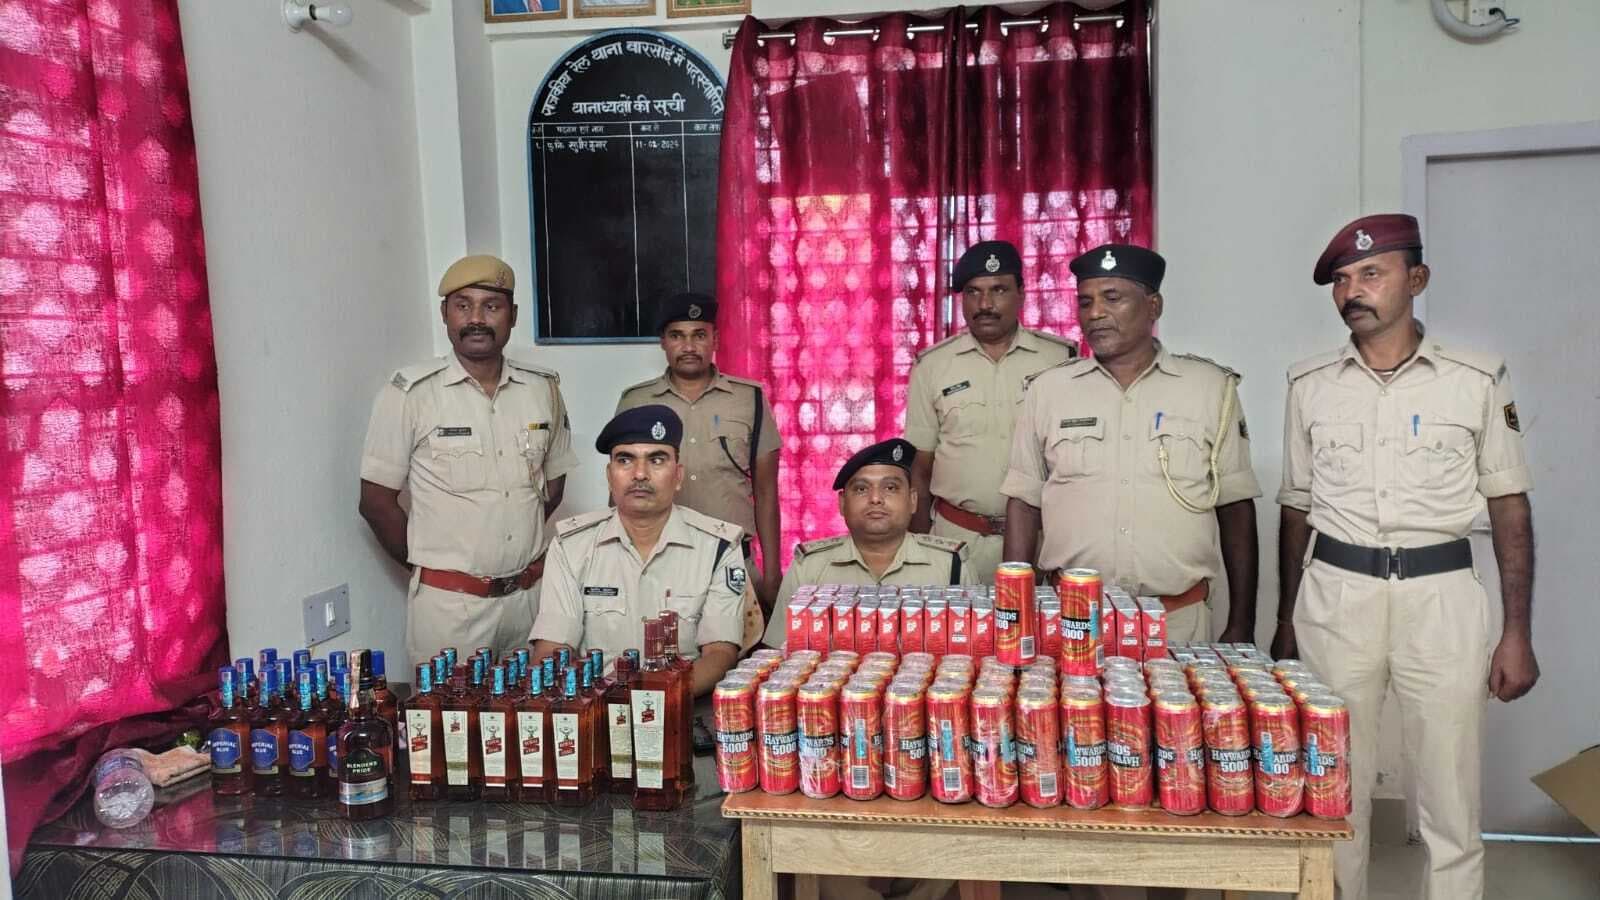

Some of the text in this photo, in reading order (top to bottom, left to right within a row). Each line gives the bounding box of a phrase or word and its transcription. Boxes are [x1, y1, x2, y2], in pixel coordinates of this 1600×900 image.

[565, 55, 591, 73] रेल
[591, 42, 623, 60] थाना
[633, 94, 651, 113] की
[653, 92, 686, 117] सूची
[723, 742, 748, 753] 5000
[1221, 759, 1248, 772] 5000
